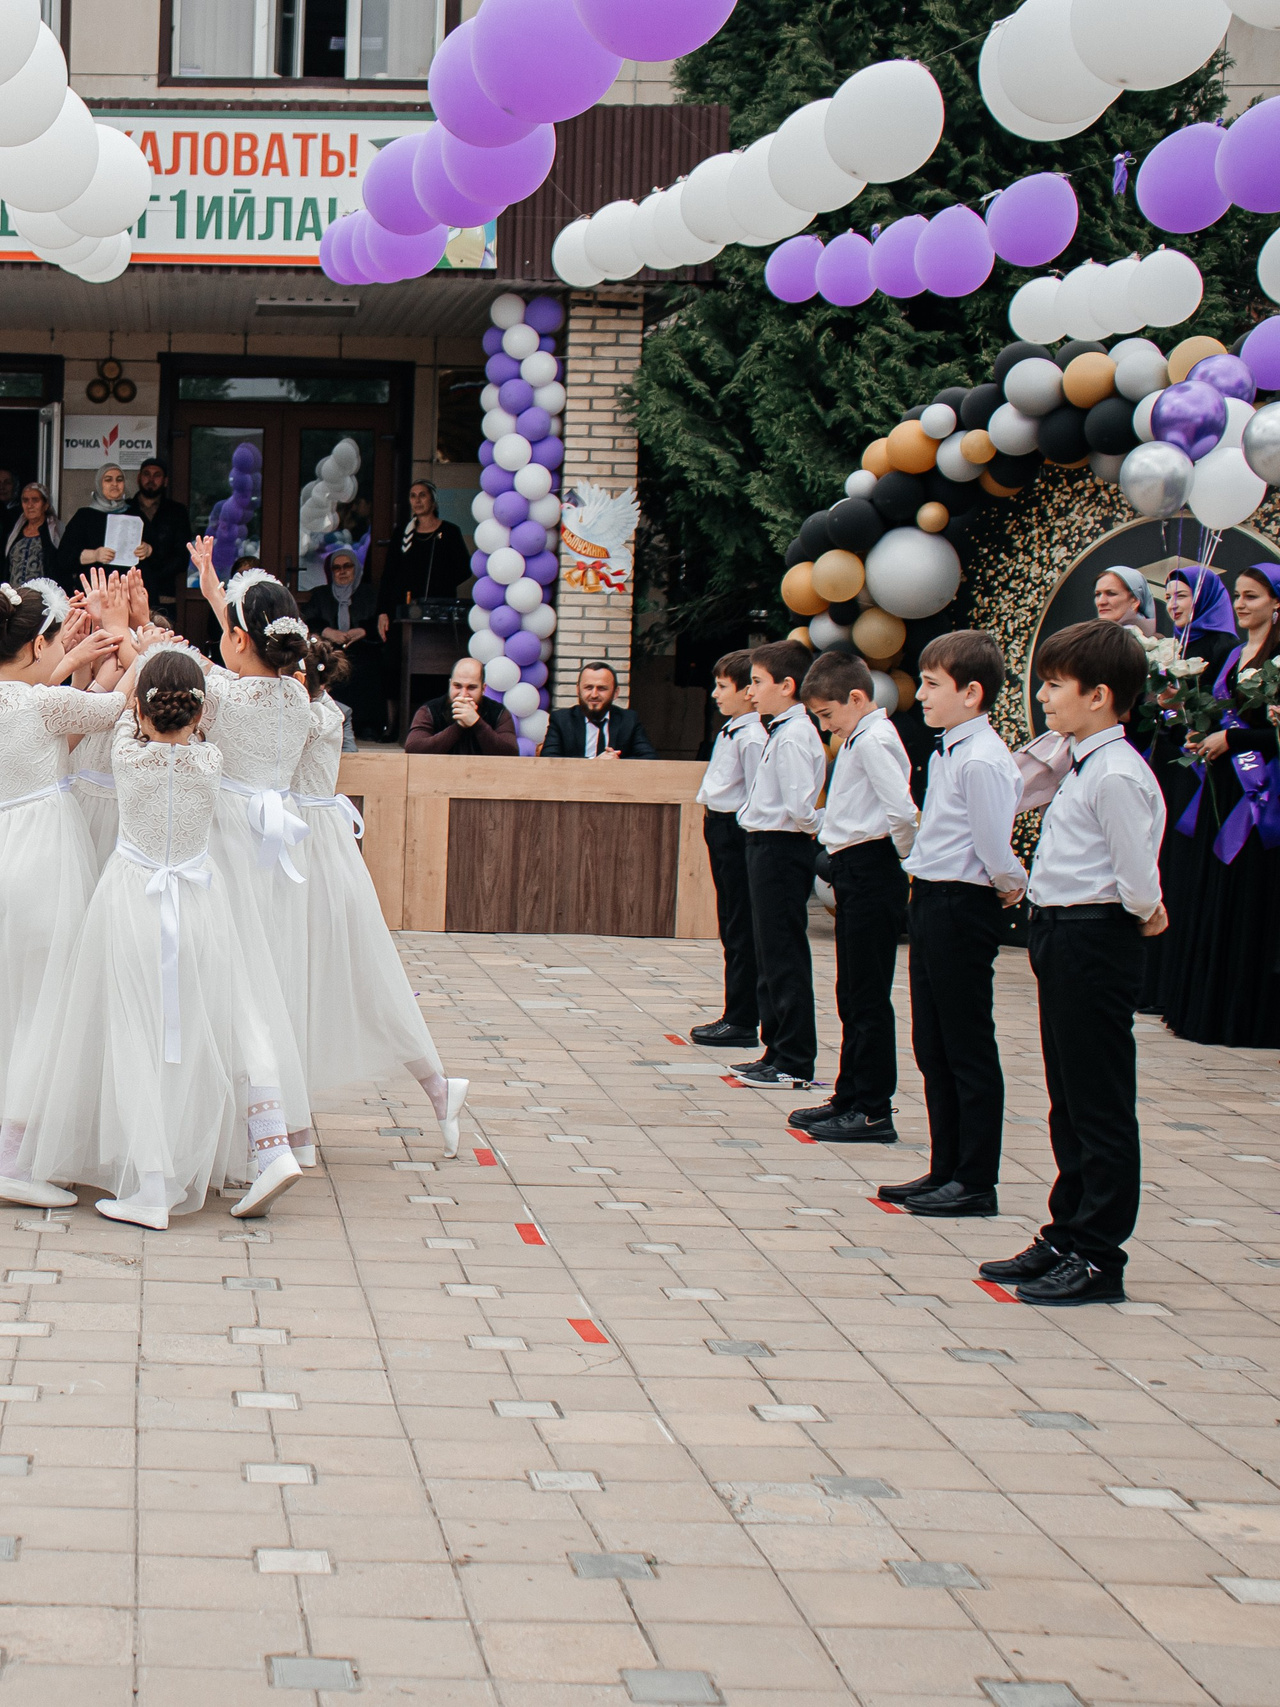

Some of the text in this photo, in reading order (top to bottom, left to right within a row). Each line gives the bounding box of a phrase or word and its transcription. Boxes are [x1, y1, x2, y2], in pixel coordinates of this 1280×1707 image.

[125, 130, 359, 178] АЛОВАТЬ!
[65, 438, 153, 449] ТОЧКА РОСТА
